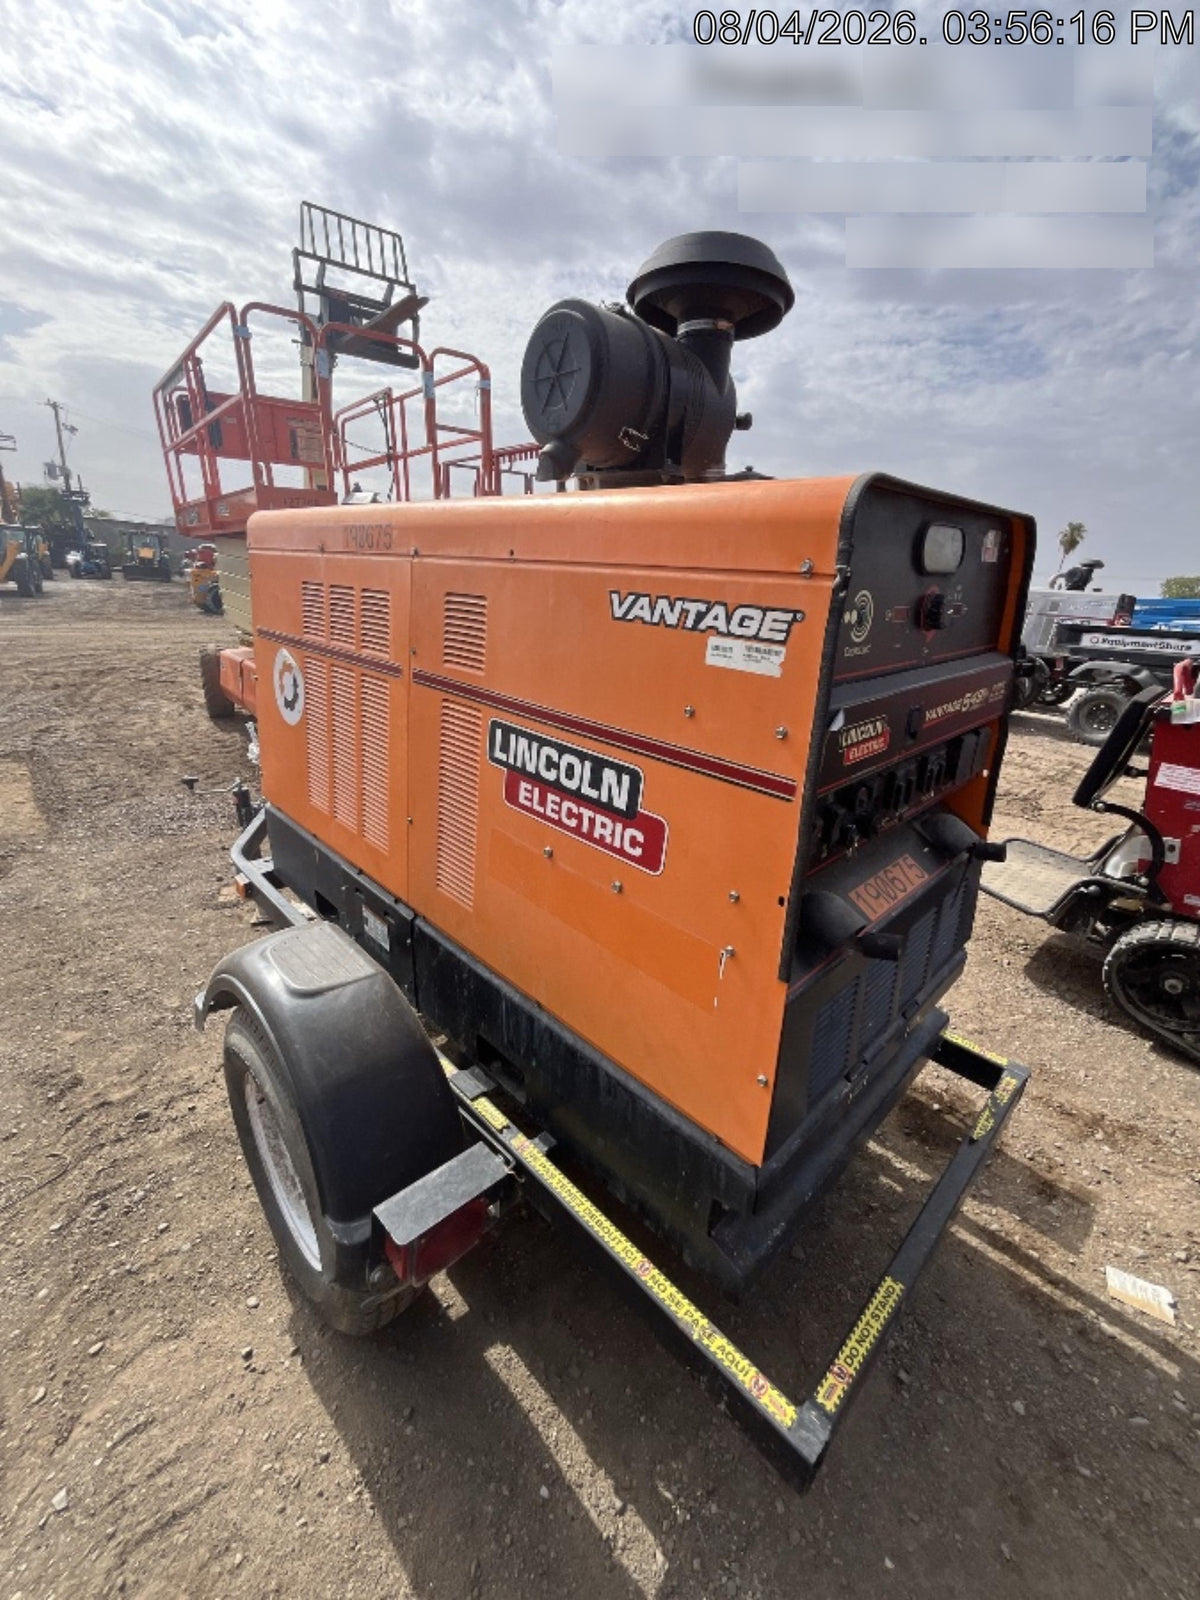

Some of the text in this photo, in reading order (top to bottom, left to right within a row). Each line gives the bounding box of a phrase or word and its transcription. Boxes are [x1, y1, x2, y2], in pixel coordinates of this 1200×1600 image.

[609, 592, 796, 642] VANTAGE
[1101, 637, 1193, 651] EquipmentShare
[842, 720, 883, 748] LINCOLN
[492, 727, 631, 812] LINCOLN
[518, 780, 645, 858] ELECTRIC
[854, 855, 926, 915] 190675
[582, 1206, 623, 1247] DEBOUT
[620, 1245, 638, 1263] ICI
[648, 1274, 668, 1294] NO
[666, 1292, 685, 1311] SE
[844, 1285, 896, 1366] DO NOT STAND
